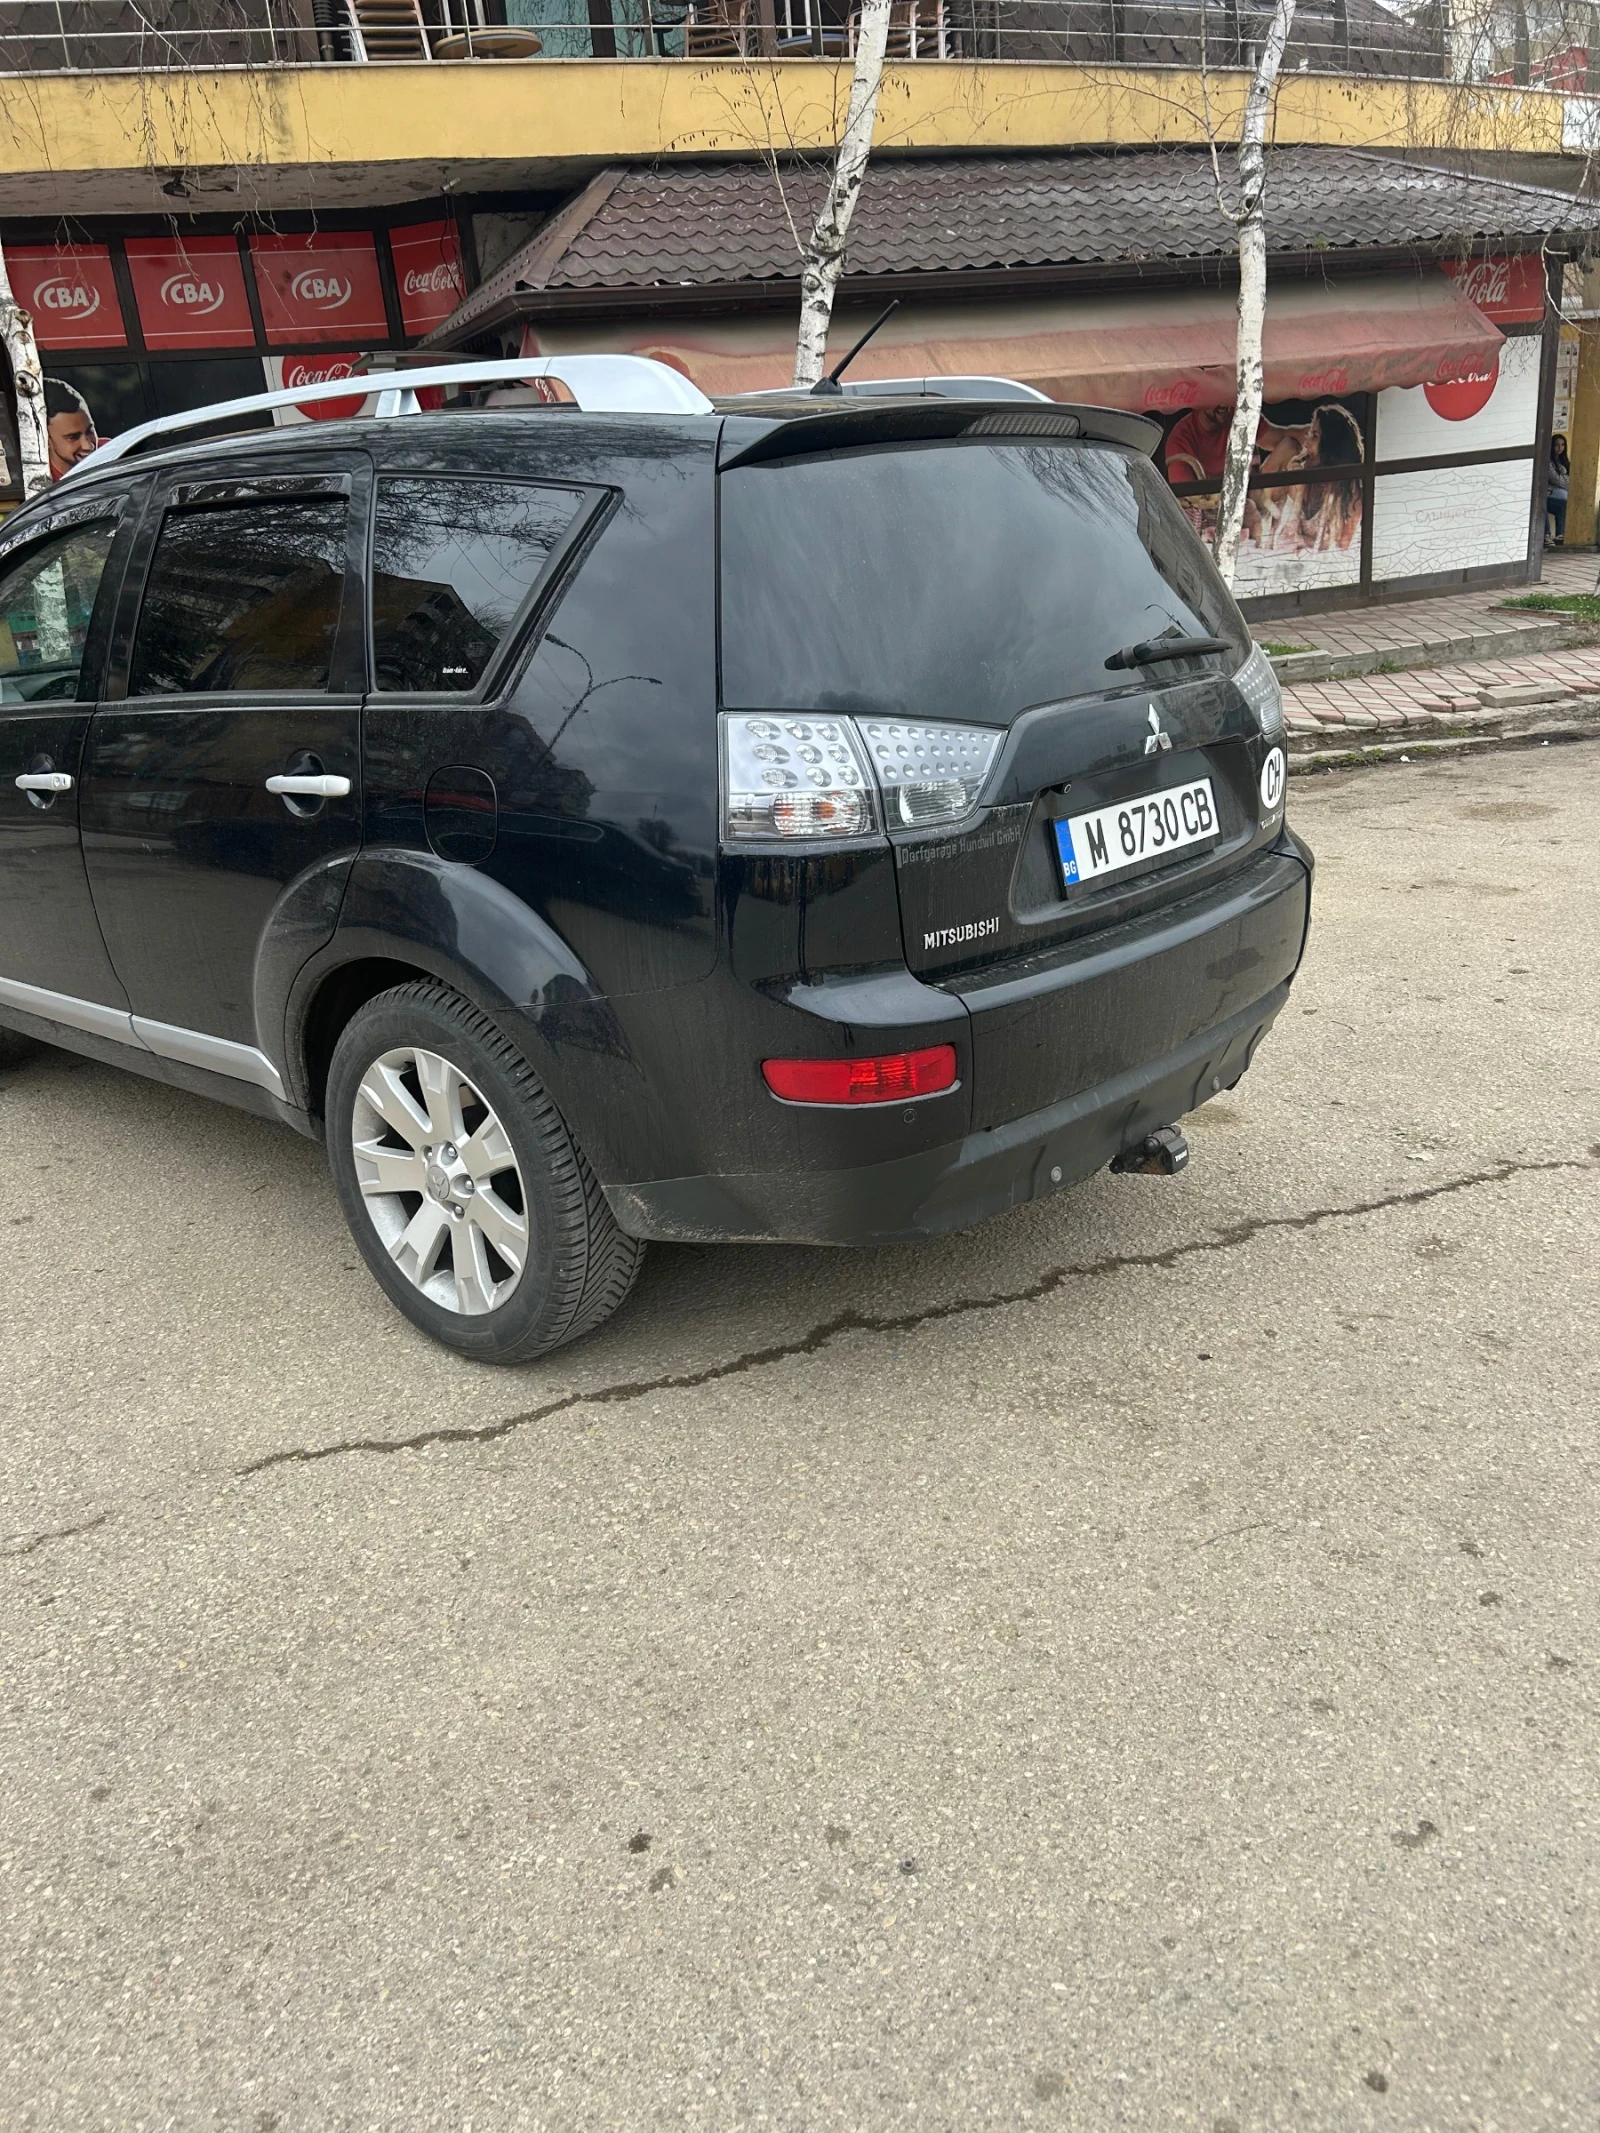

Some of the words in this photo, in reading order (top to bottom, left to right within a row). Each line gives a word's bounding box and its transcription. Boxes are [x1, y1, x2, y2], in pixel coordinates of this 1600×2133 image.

[300, 278, 342, 299] CBA
[404, 261, 461, 296] Coca-Cola
[43, 286, 90, 309] CBA
[170, 283, 215, 304] CBA
[1144, 380, 1199, 407] Coca-Cola
[1267, 752, 1281, 801] CH
[1085, 818, 1109, 868] M
[1063, 860, 1077, 877] BG
[923, 916, 1000, 950] MITSUBISHI
